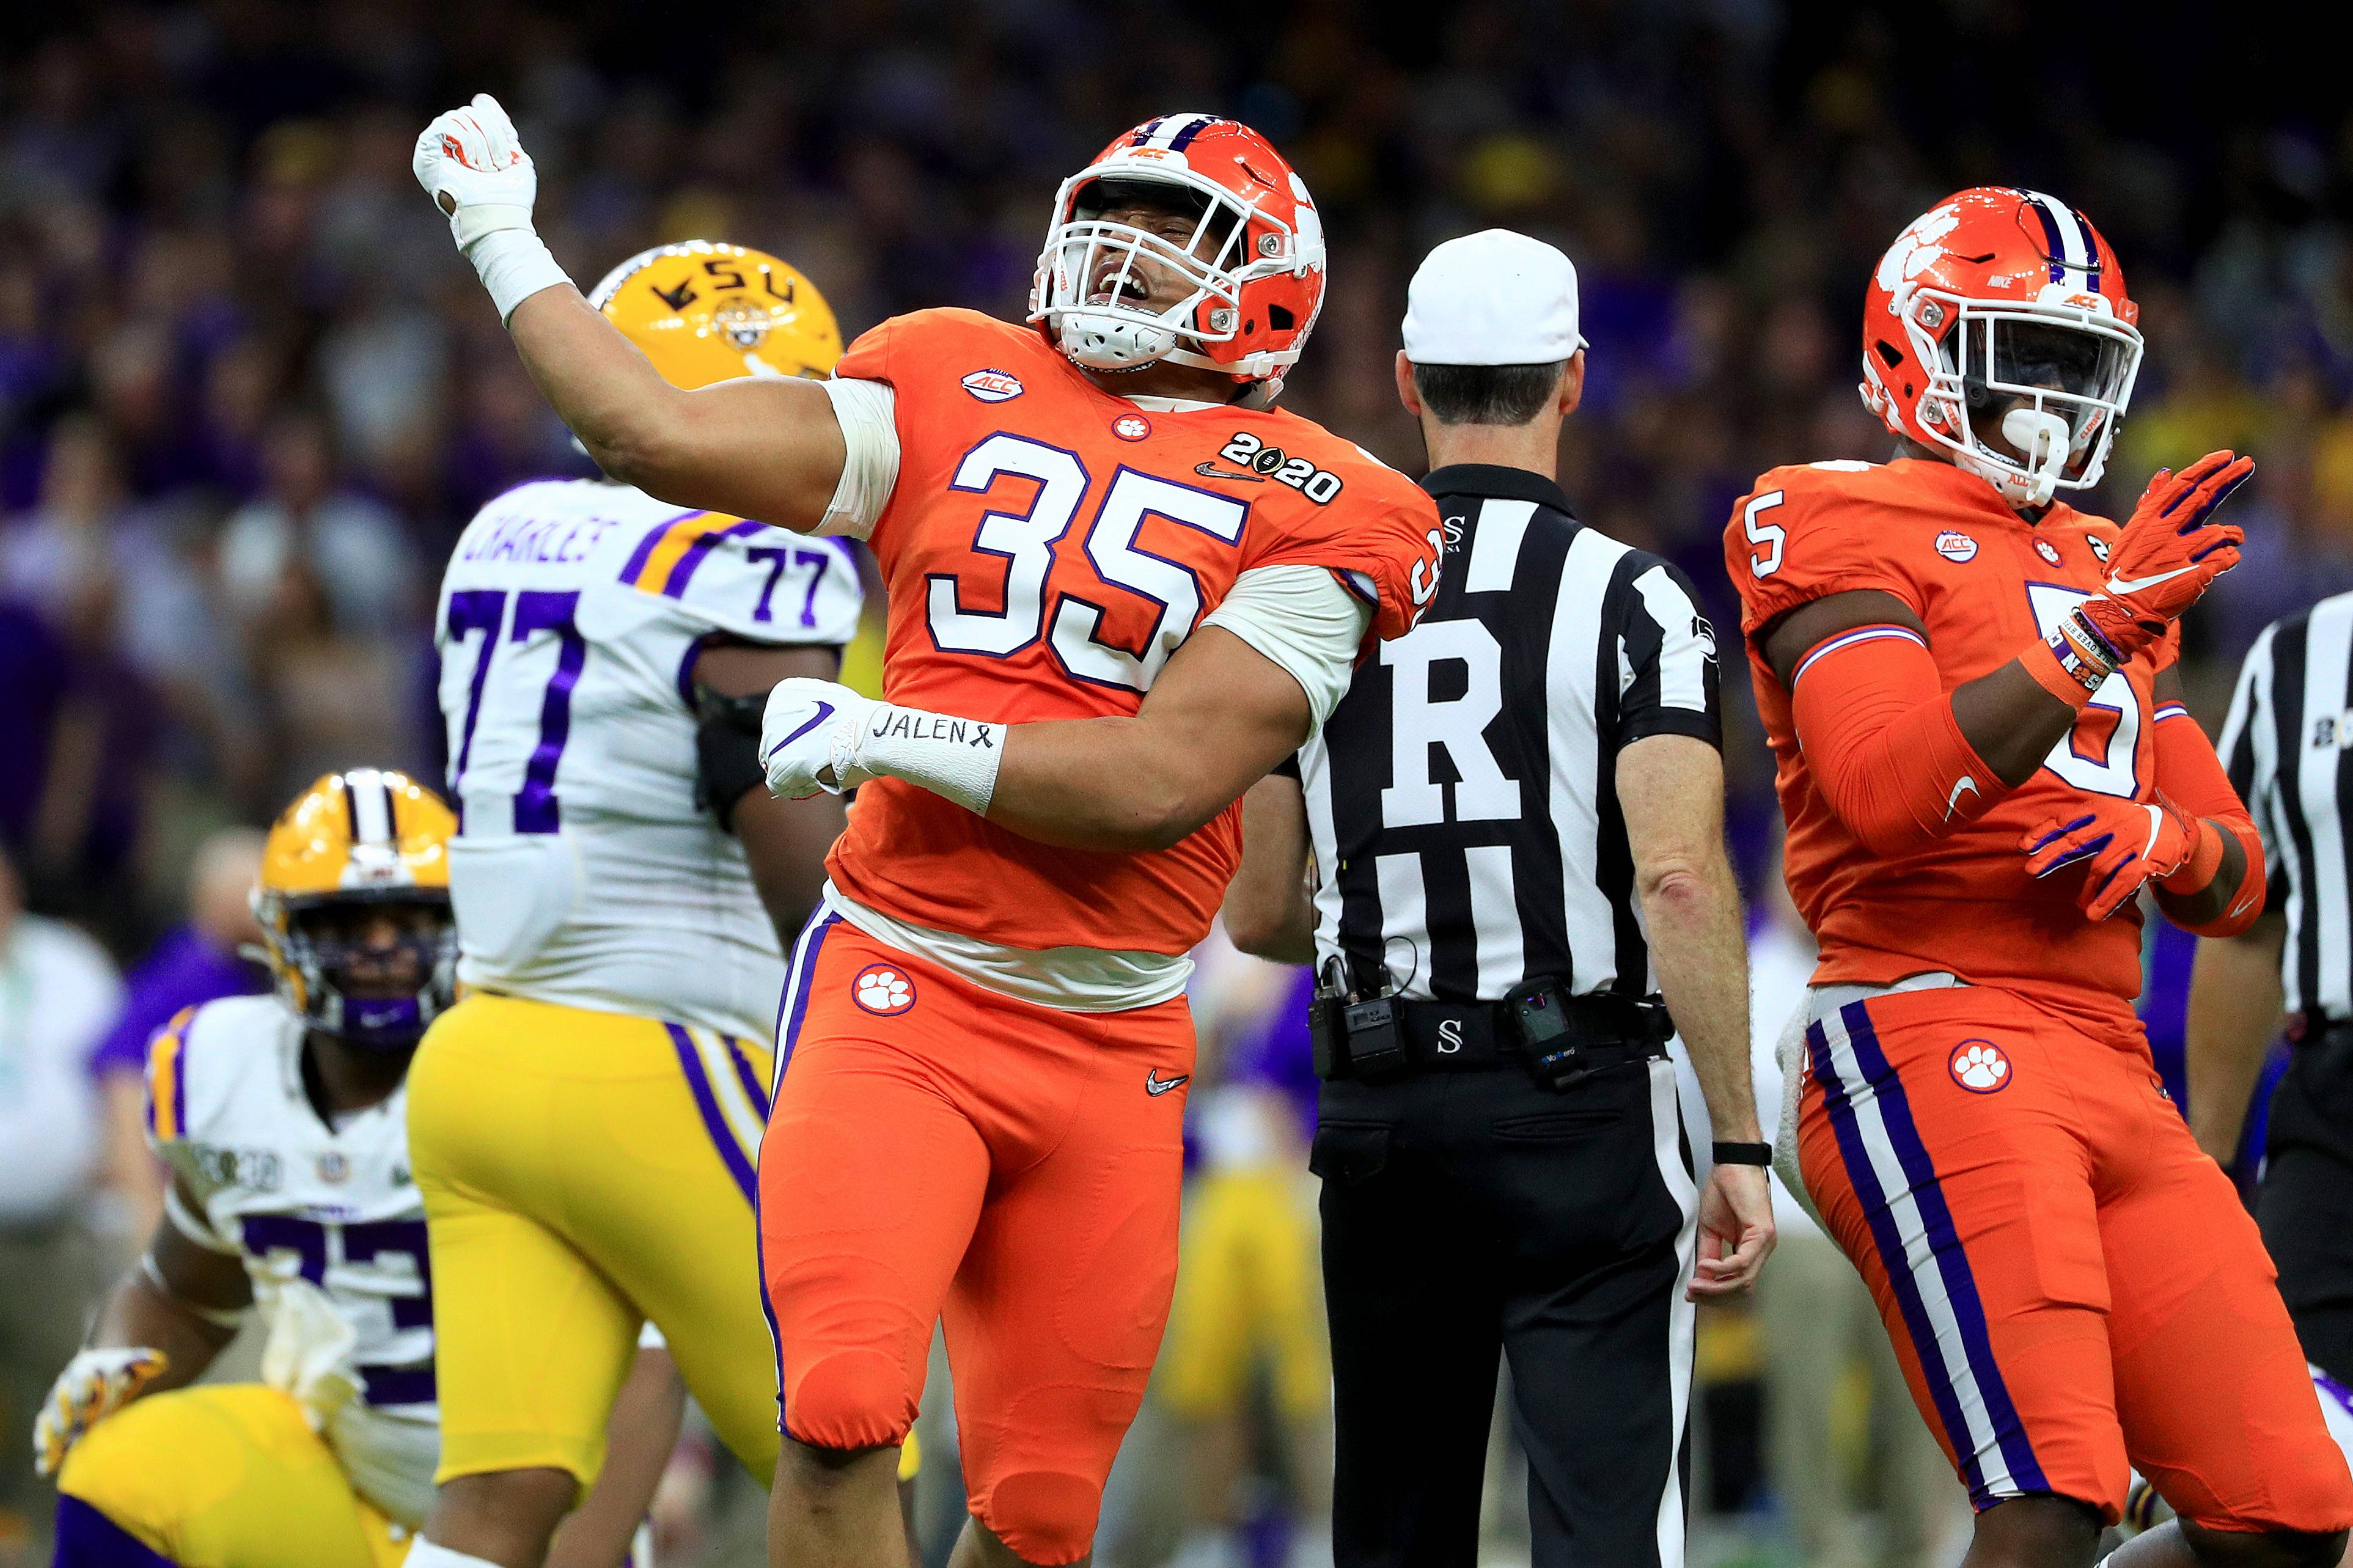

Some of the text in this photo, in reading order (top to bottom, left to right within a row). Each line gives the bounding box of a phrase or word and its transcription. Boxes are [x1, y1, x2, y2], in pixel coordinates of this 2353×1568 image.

[1128, 147, 1169, 159] ACC
[1986, 274, 2014, 289] NIKE
[2063, 293, 2099, 309] ACC
[968, 376, 1019, 392] ACC
[1743, 489, 1786, 580] 5
[1942, 538, 1972, 550] ACC
[925, 430, 1250, 693] 35
[747, 548, 829, 628] 77
[2077, 632, 2097, 651] OVER
[447, 591, 587, 836] 77
[873, 711, 967, 743] JALEN
[1379, 618, 1522, 829] R
[1437, 1019, 1463, 1053] S
